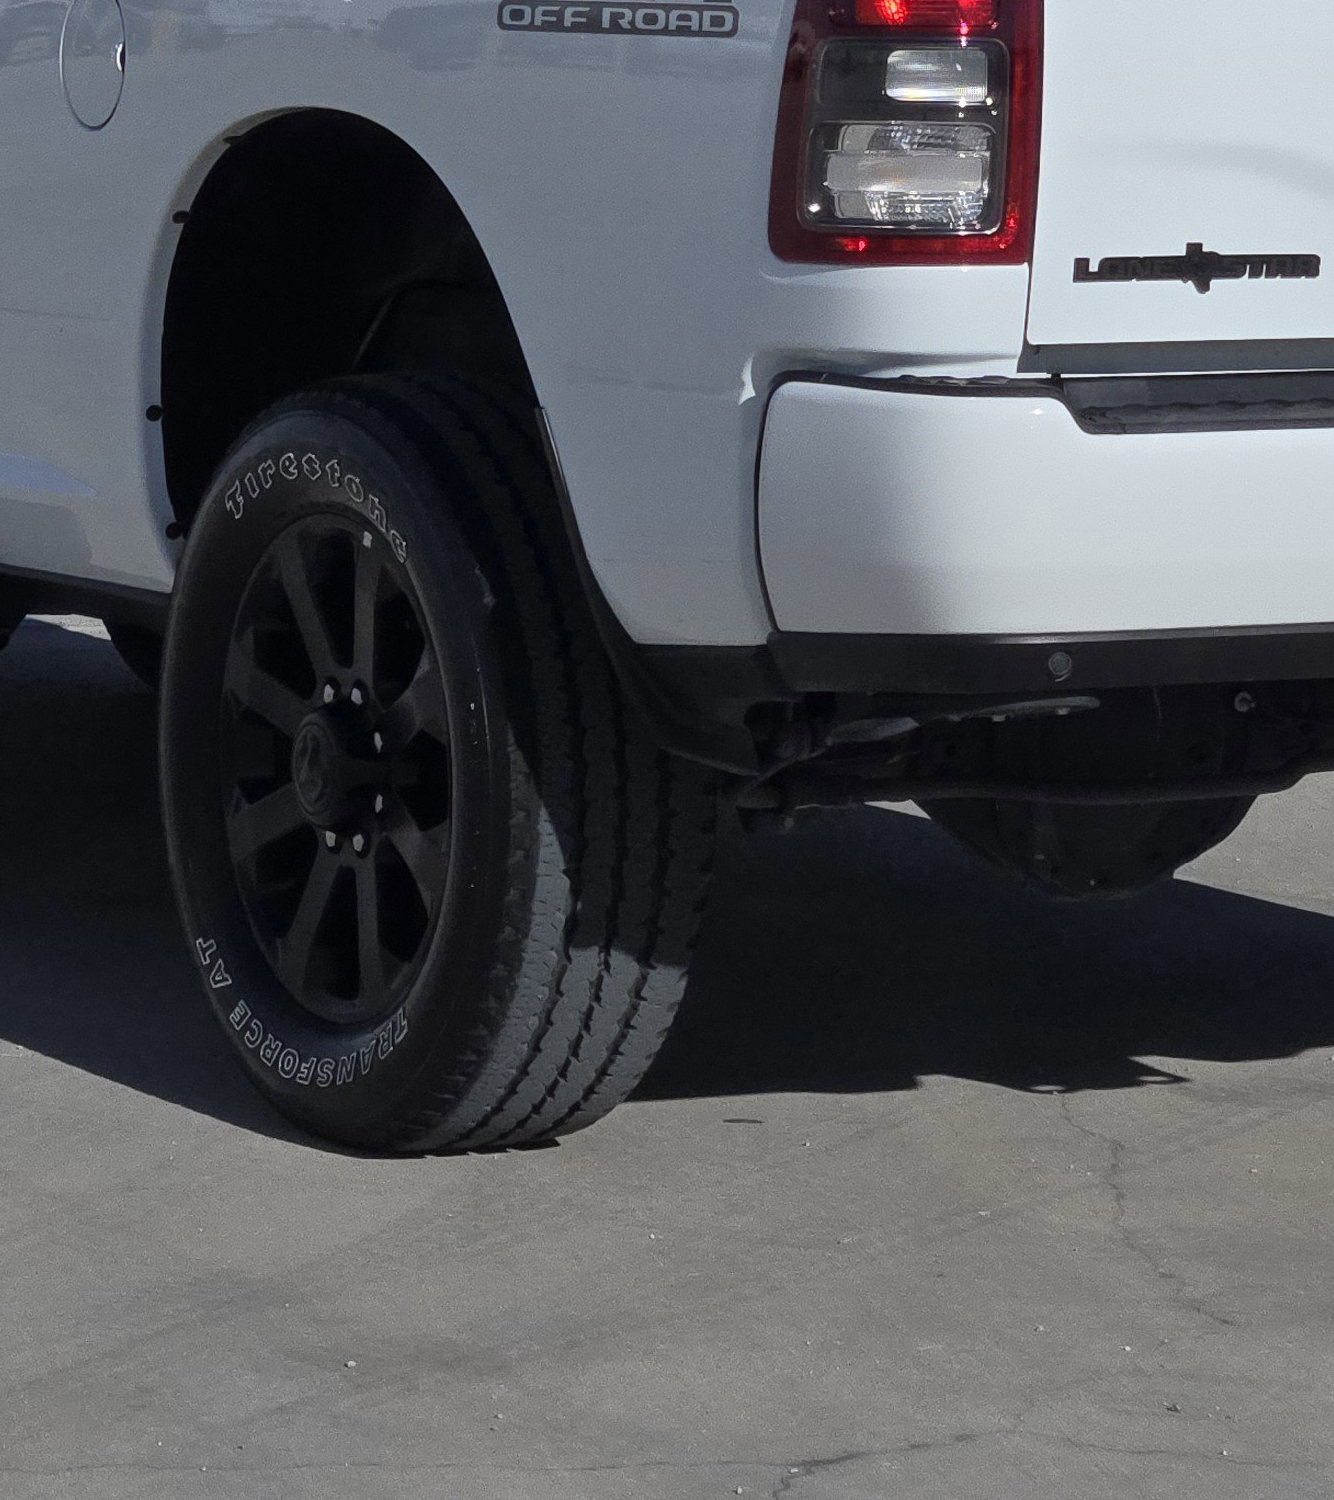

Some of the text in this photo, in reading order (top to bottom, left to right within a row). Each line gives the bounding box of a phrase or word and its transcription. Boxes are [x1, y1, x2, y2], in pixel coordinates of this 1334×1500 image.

[501, 4, 734, 32] OFF ROAD
[224, 452, 407, 564] Firestone
[196, 937, 409, 1088] TRANSFORCE AT
